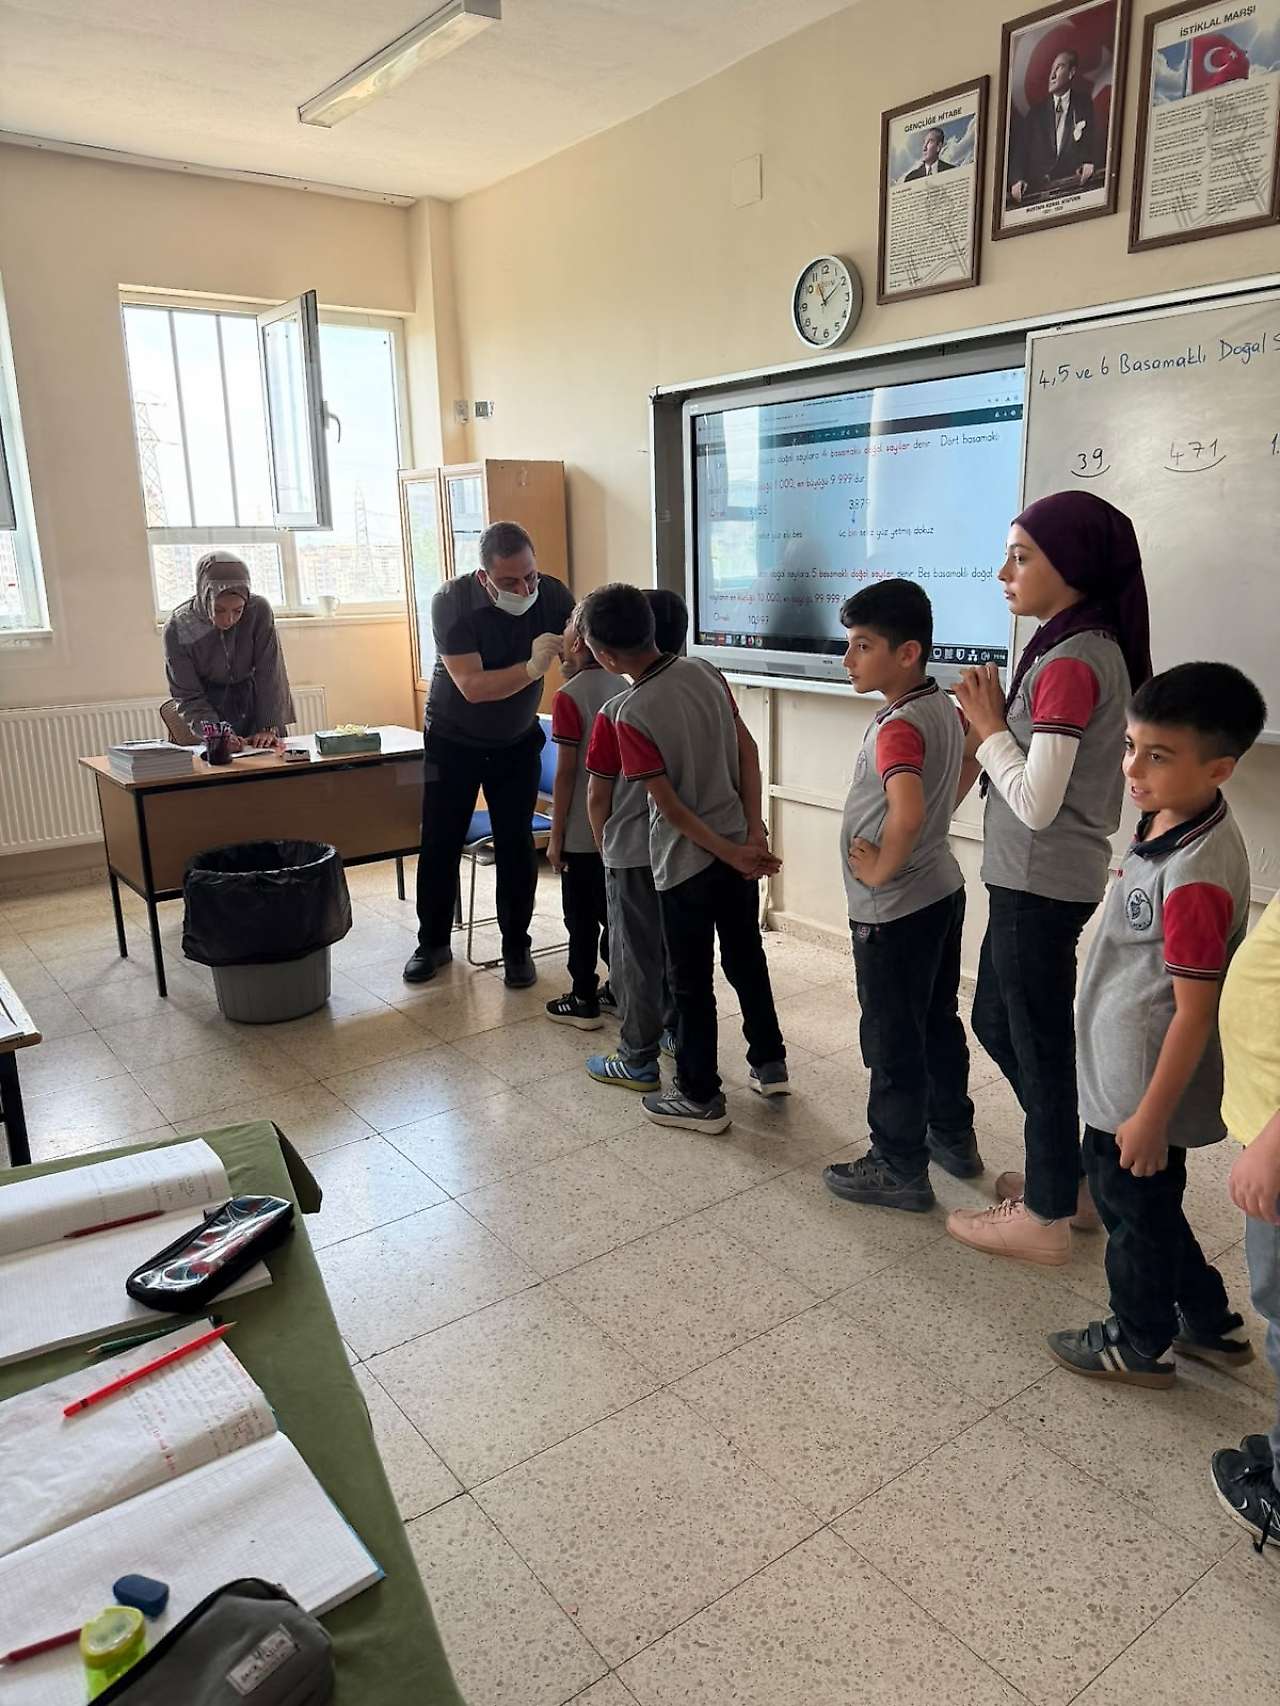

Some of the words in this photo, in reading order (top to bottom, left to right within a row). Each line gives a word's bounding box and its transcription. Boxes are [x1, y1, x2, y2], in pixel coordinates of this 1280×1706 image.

[1180, 17, 1221, 37] İSTİKLAL
[1224, 5, 1256, 23] MARŞI
[1076, 369, 1093, 380] ve
[1101, 356, 1109, 375] 6
[1120, 345, 1206, 374] Basamaklı
[1218, 332, 1266, 365] Doğal
[1078, 447, 1103, 470] 39
[1170, 438, 1218, 465] 471
[971, 567, 993, 581] doğal
